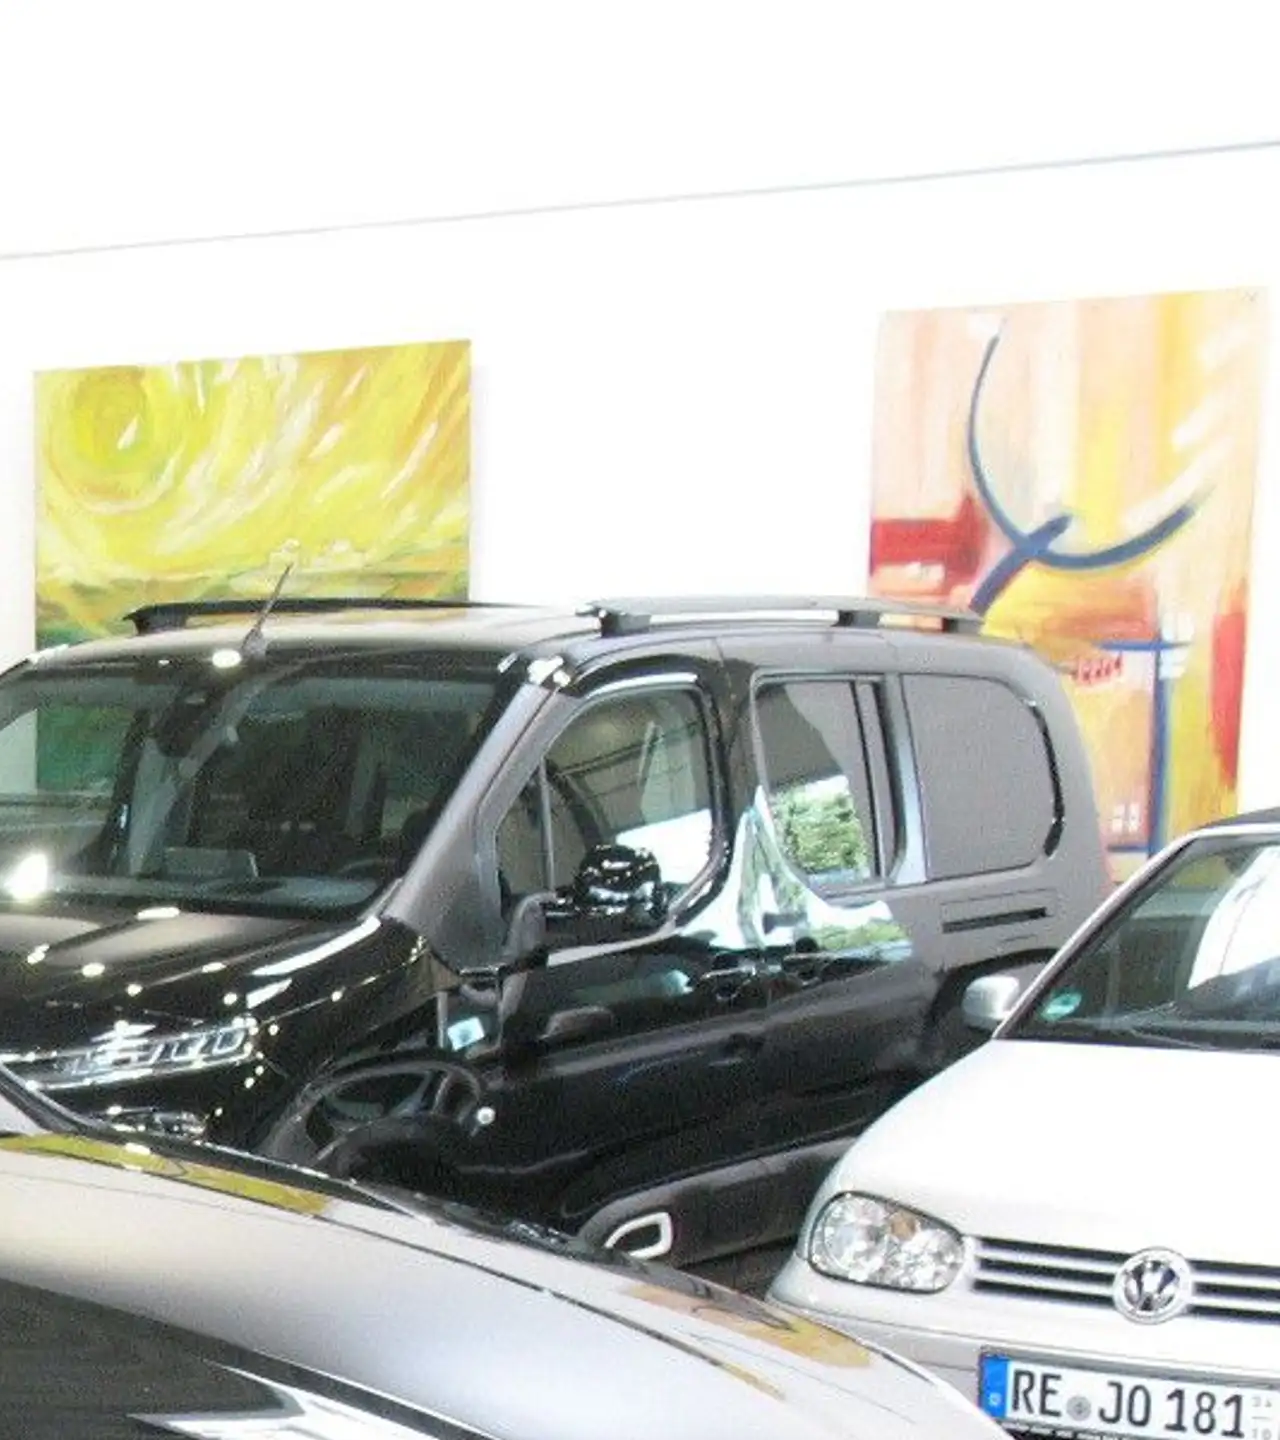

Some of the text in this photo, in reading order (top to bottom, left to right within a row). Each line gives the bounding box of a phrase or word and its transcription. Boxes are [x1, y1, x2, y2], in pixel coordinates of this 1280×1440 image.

[1013, 1369, 1245, 1439] RE JO 181
